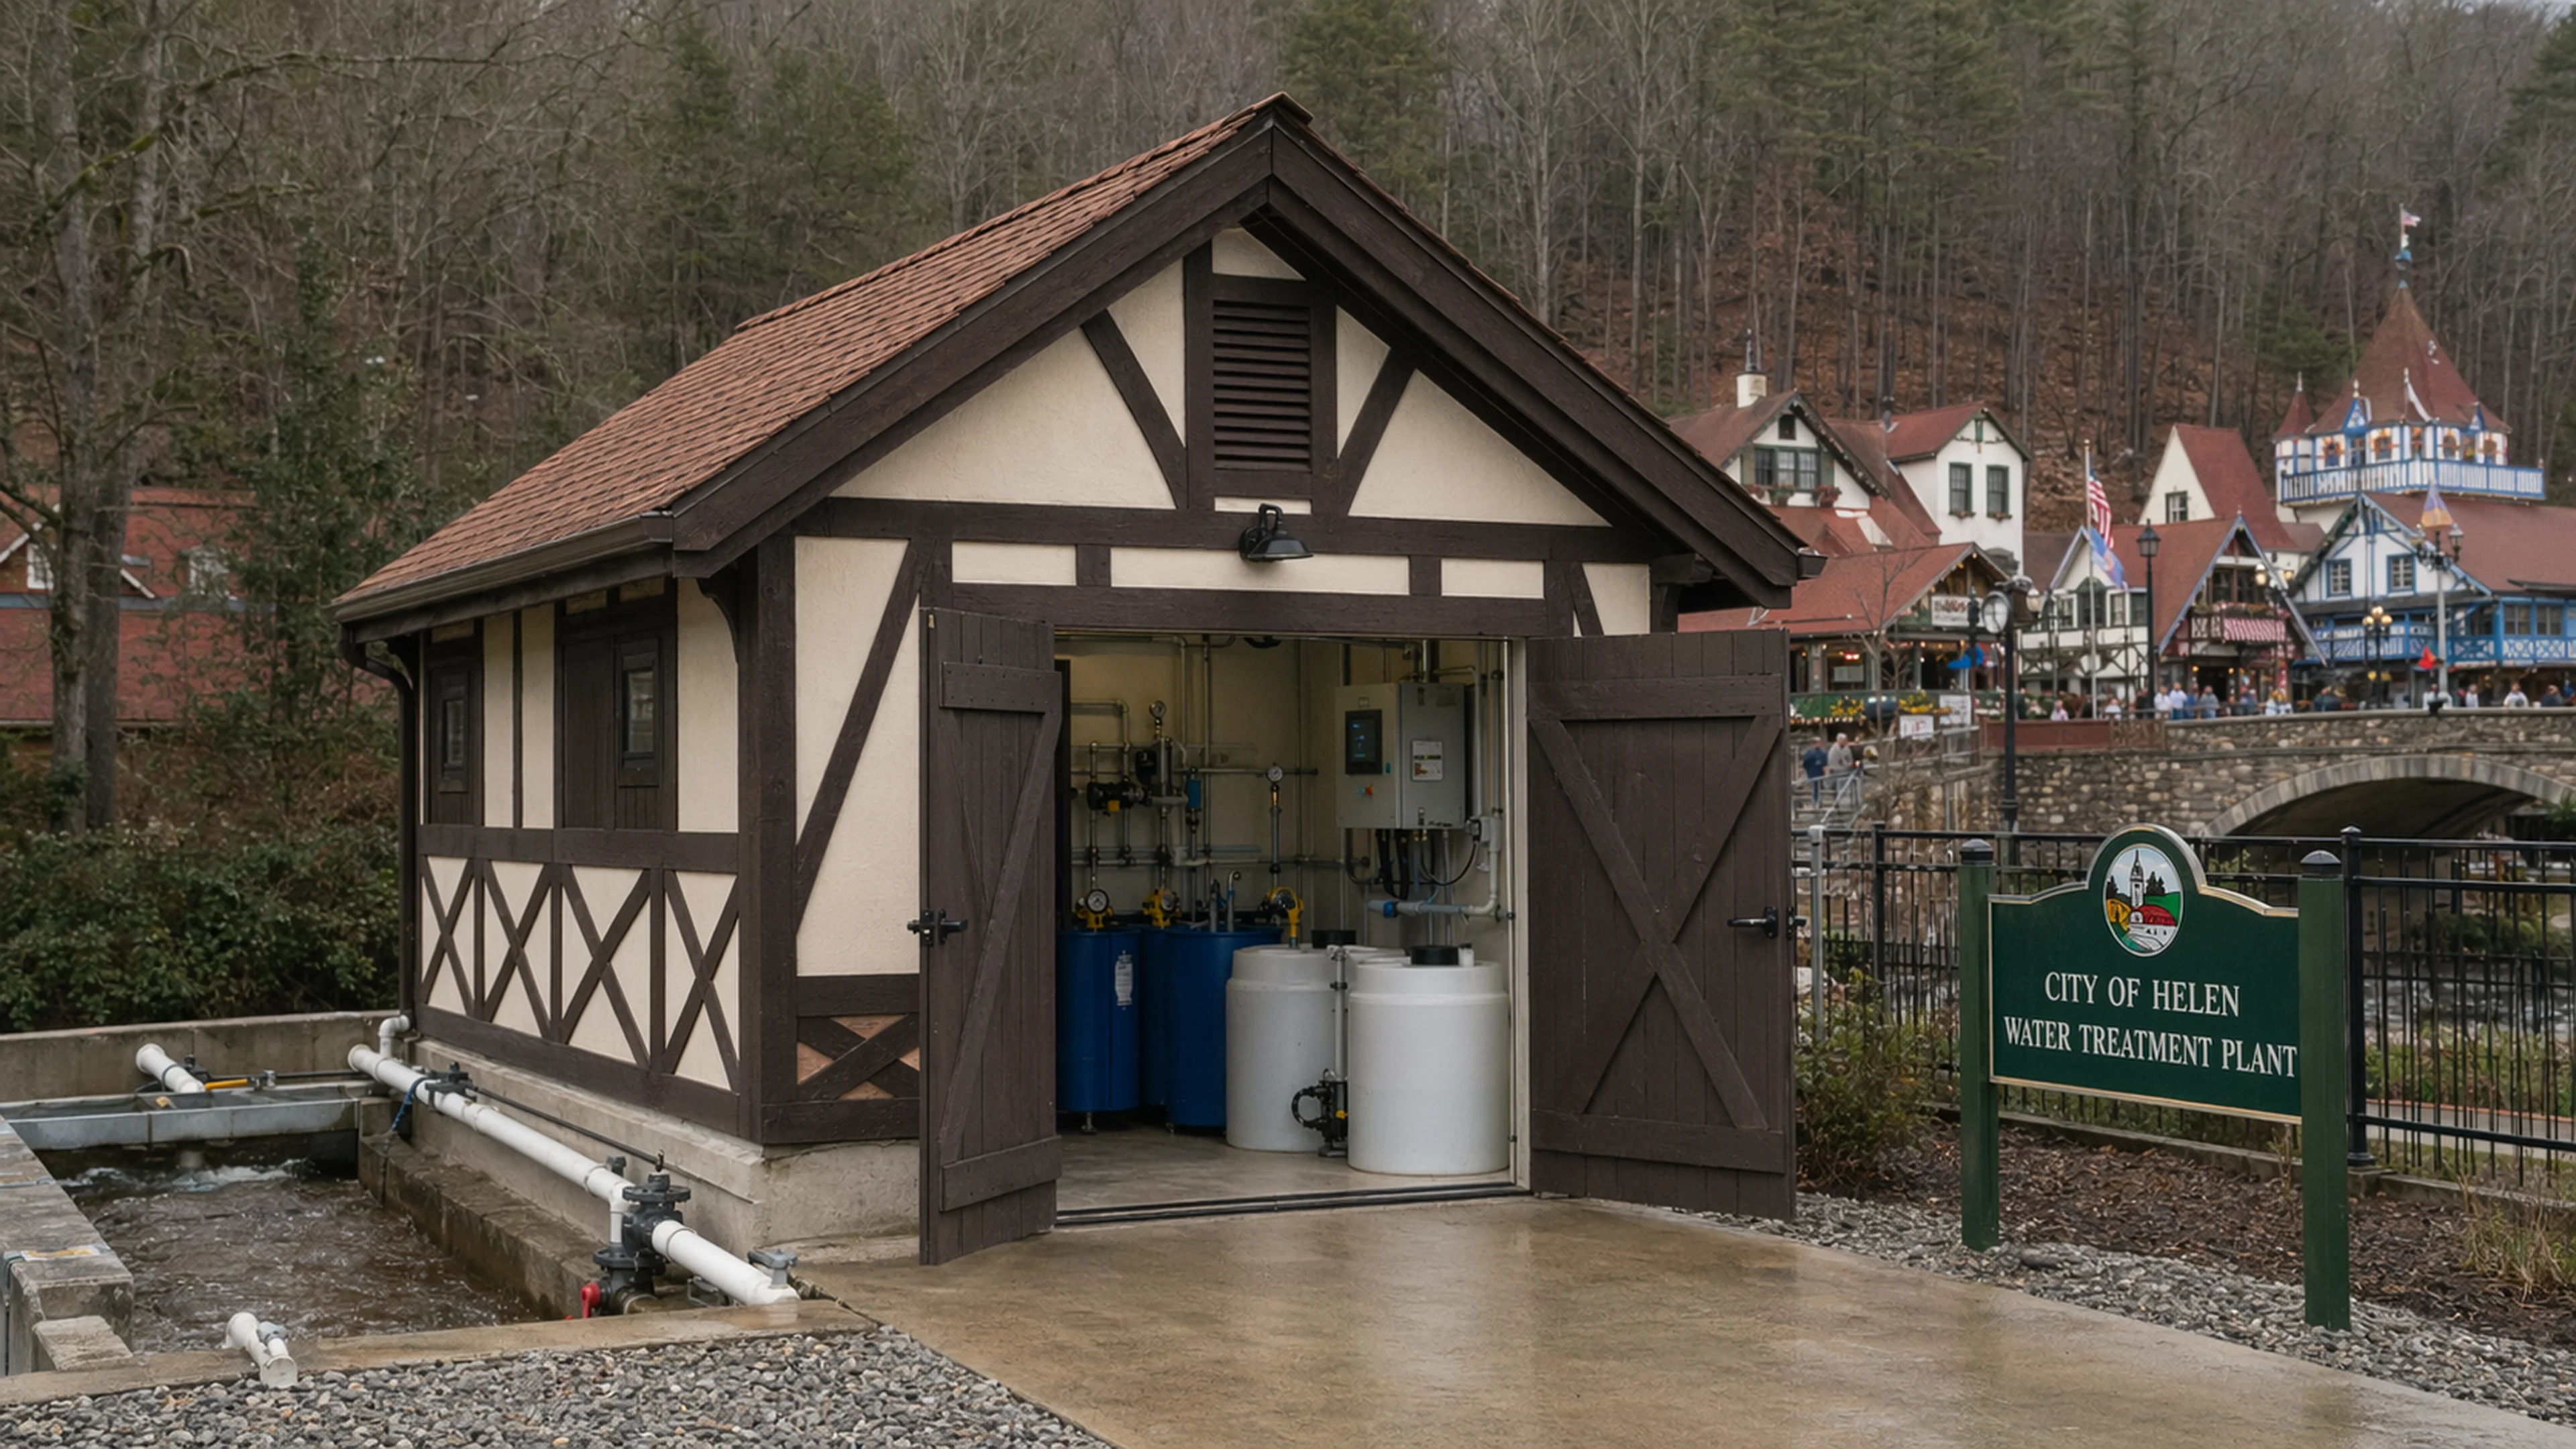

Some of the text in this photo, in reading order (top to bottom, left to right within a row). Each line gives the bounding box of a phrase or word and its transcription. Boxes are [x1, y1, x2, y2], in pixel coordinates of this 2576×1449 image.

[2045, 971, 2240, 1017] CITY OF HELEN
[2004, 1016, 2298, 1077] WATER TREATMENT PLANT
